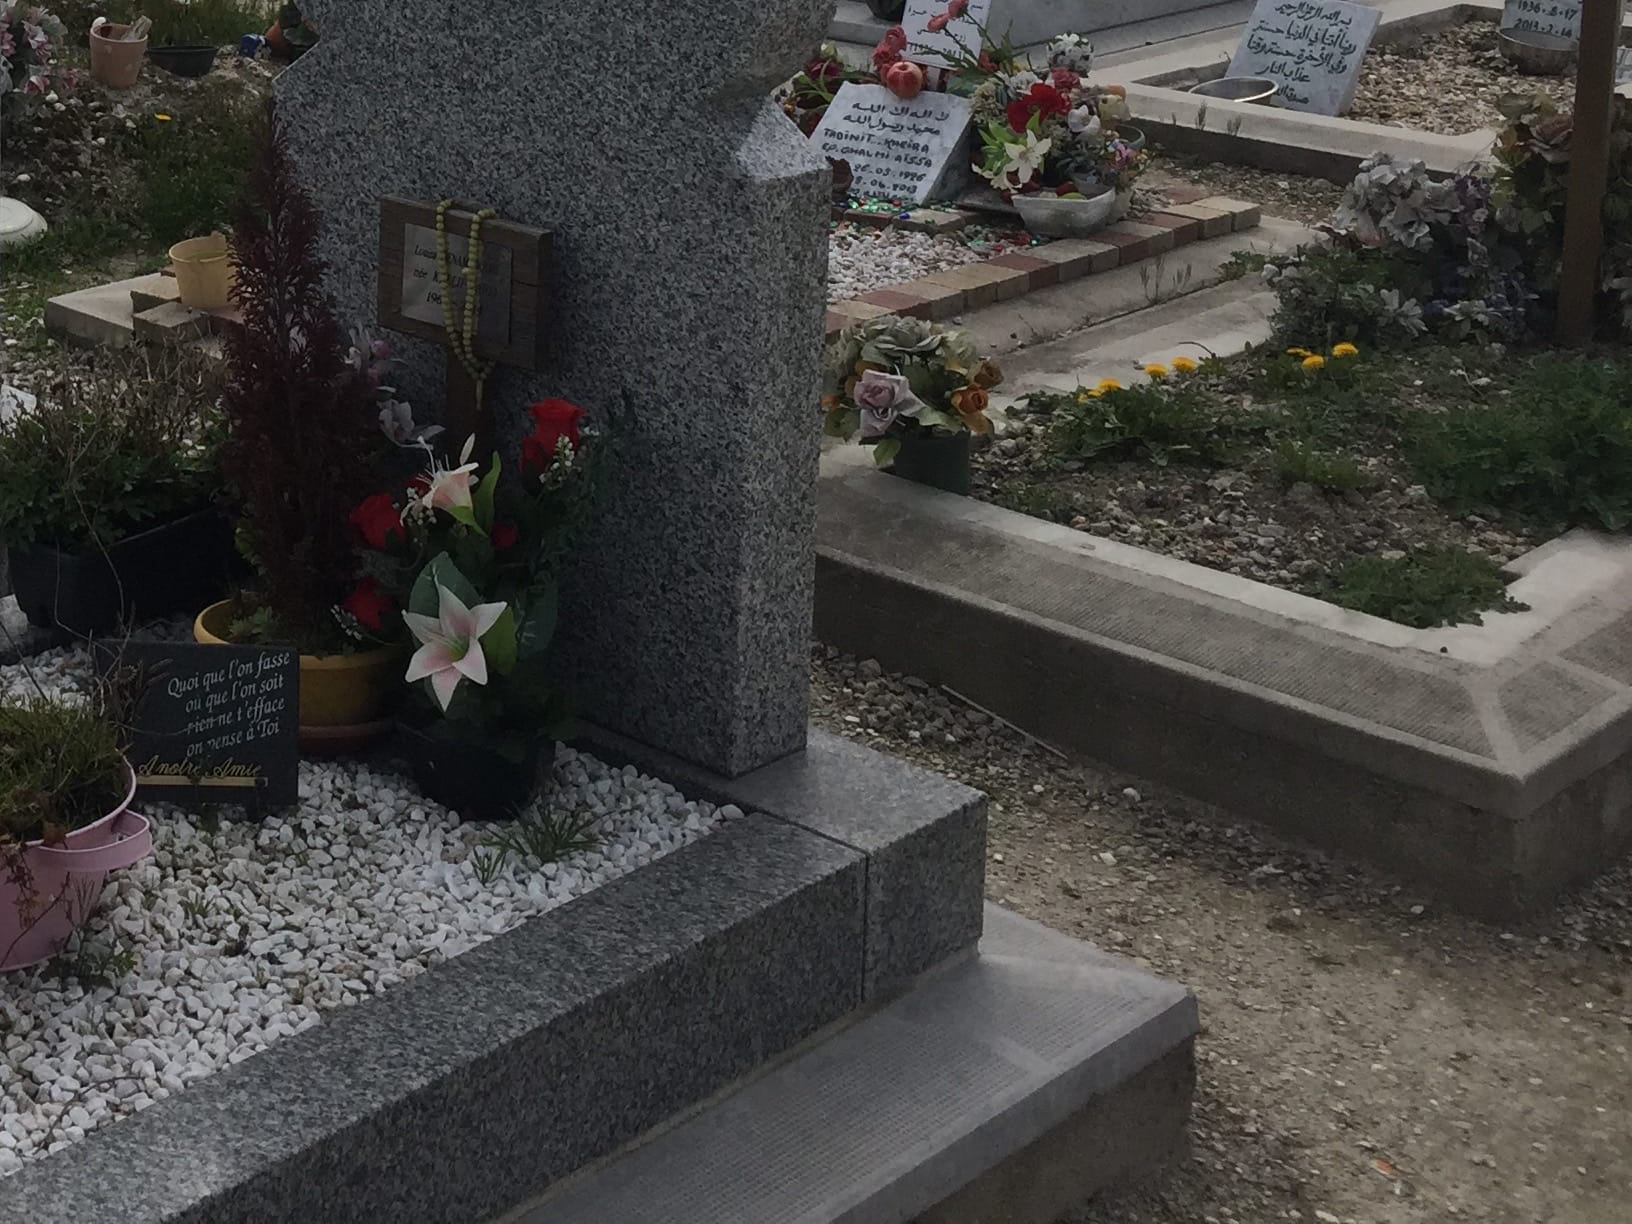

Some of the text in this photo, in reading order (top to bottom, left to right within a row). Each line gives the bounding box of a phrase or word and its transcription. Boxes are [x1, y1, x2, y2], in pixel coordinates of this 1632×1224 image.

[168, 650, 291, 699] Quoi que l'on fasse
[205, 690, 228, 714] que
[231, 680, 257, 701] l'on
[259, 673, 284, 693] soit
[186, 742, 204, 757] on
[256, 716, 281, 738] Toi
[218, 711, 233, 726] ne
